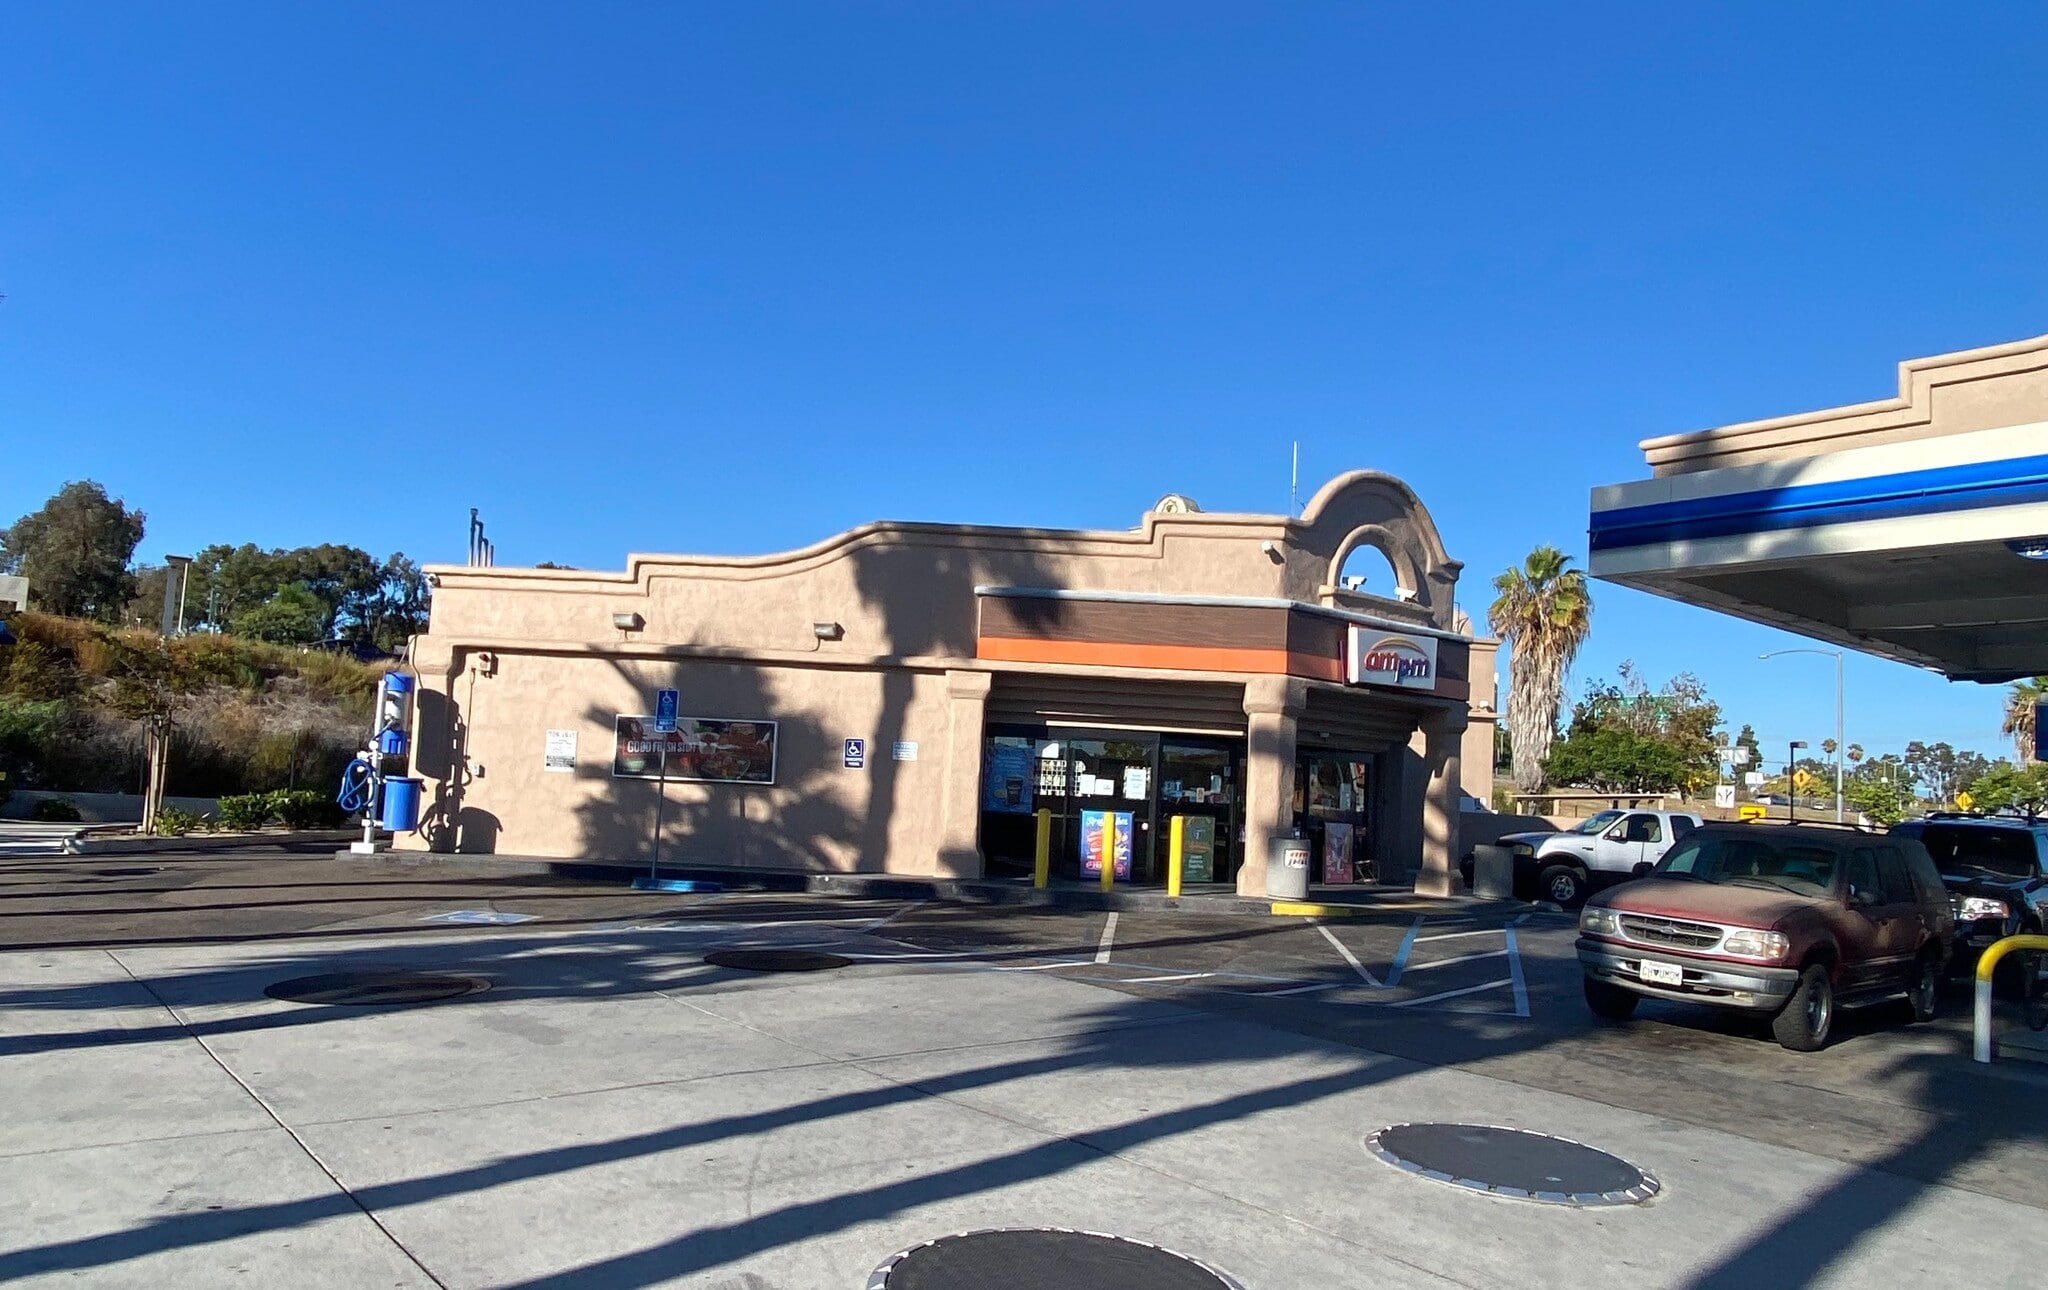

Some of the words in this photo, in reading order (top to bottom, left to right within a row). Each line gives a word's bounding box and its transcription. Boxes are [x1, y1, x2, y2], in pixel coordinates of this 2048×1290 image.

[1364, 649, 1430, 684] ampm
[627, 740, 652, 753] GOOD
[652, 740, 677, 753] FRSH
